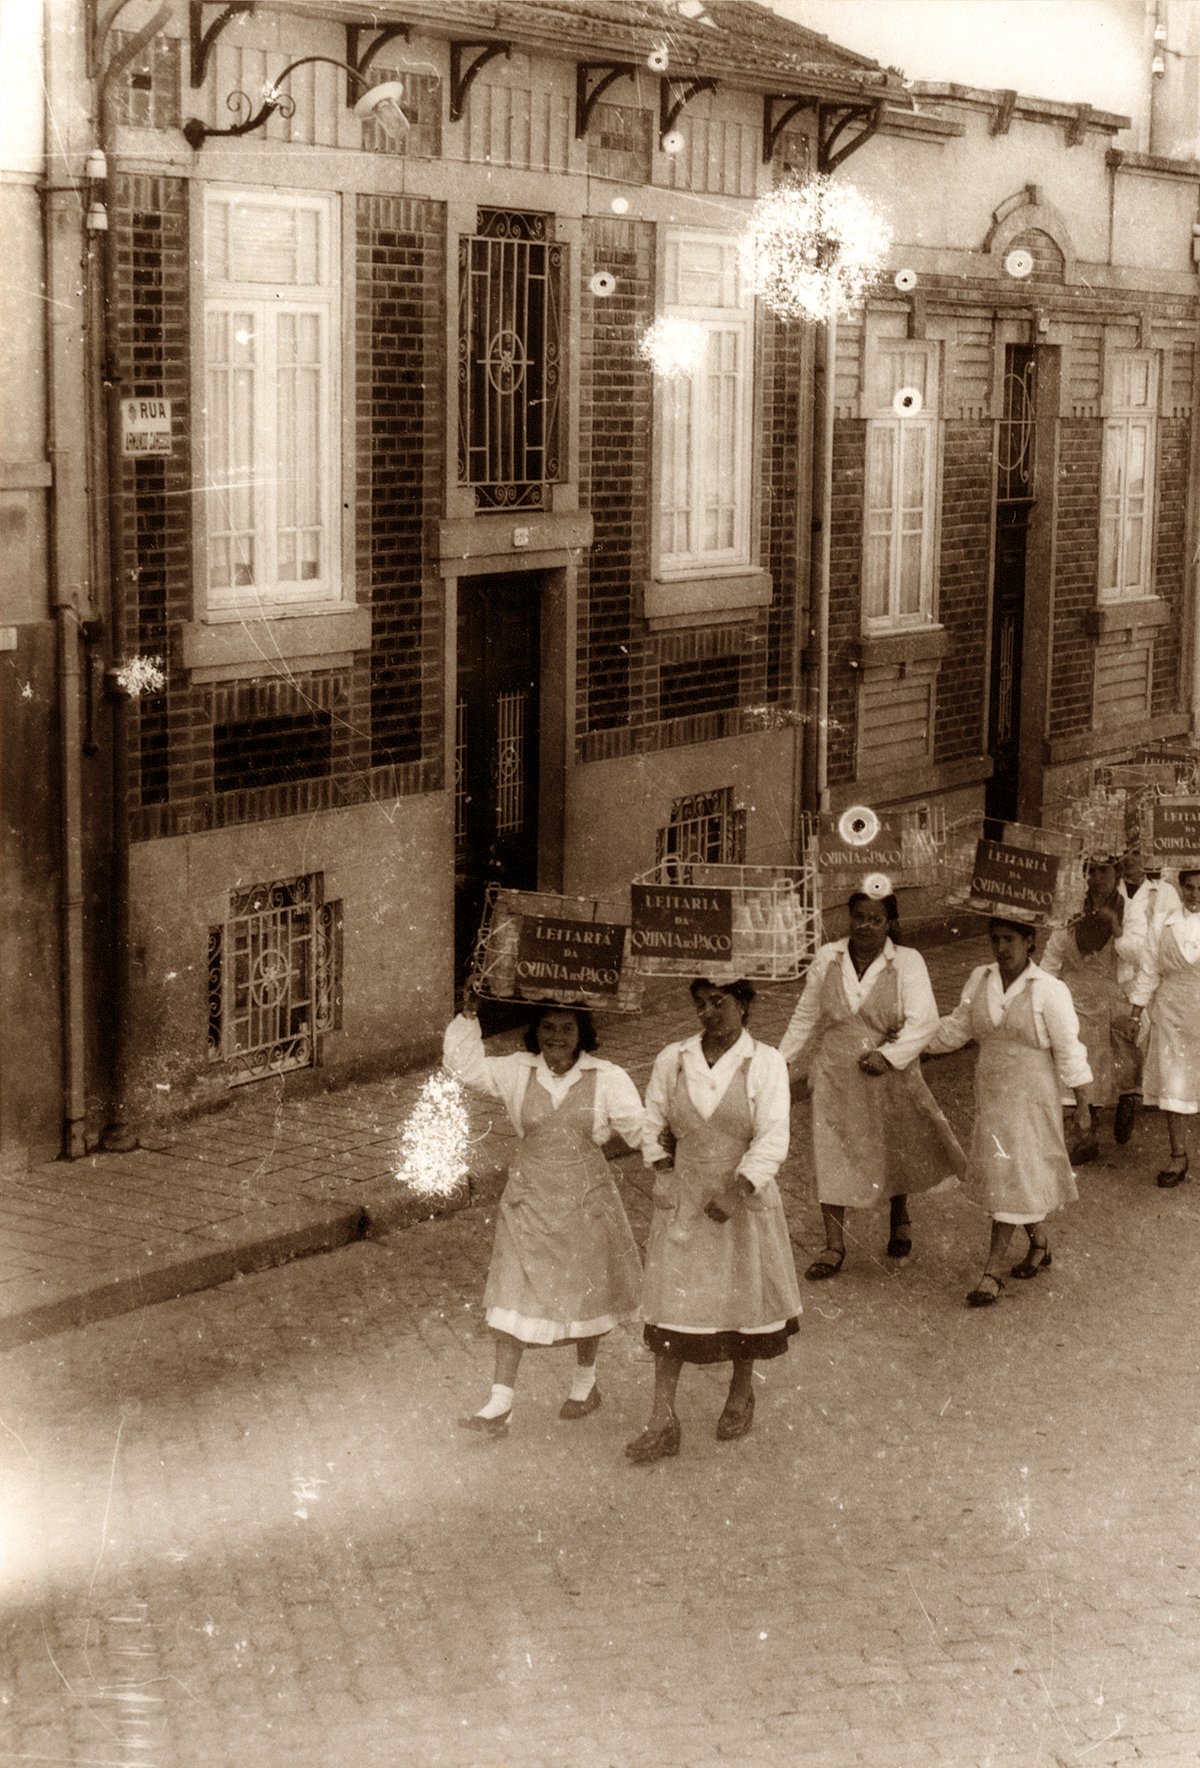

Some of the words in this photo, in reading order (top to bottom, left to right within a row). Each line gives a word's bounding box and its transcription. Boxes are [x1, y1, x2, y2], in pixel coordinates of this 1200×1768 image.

[140, 402, 167, 419] RUA
[1154, 837, 1191, 850] QUINTA
[820, 851, 860, 867] QUINTA
[870, 850, 901, 866] PAÇO
[988, 847, 1048, 872] LEITARIA
[972, 877, 1013, 898] QUINTA
[1022, 887, 1053, 905] PAÇO
[646, 894, 719, 911] LEITARIA
[674, 916, 690, 926] DA
[536, 925, 611, 946] LEITARIA
[632, 930, 682, 948] QUINTA
[694, 933, 731, 952] PAÇO
[563, 948, 578, 958] DA
[517, 960, 569, 980] QUINTA
[581, 966, 619, 986] PAÇO
